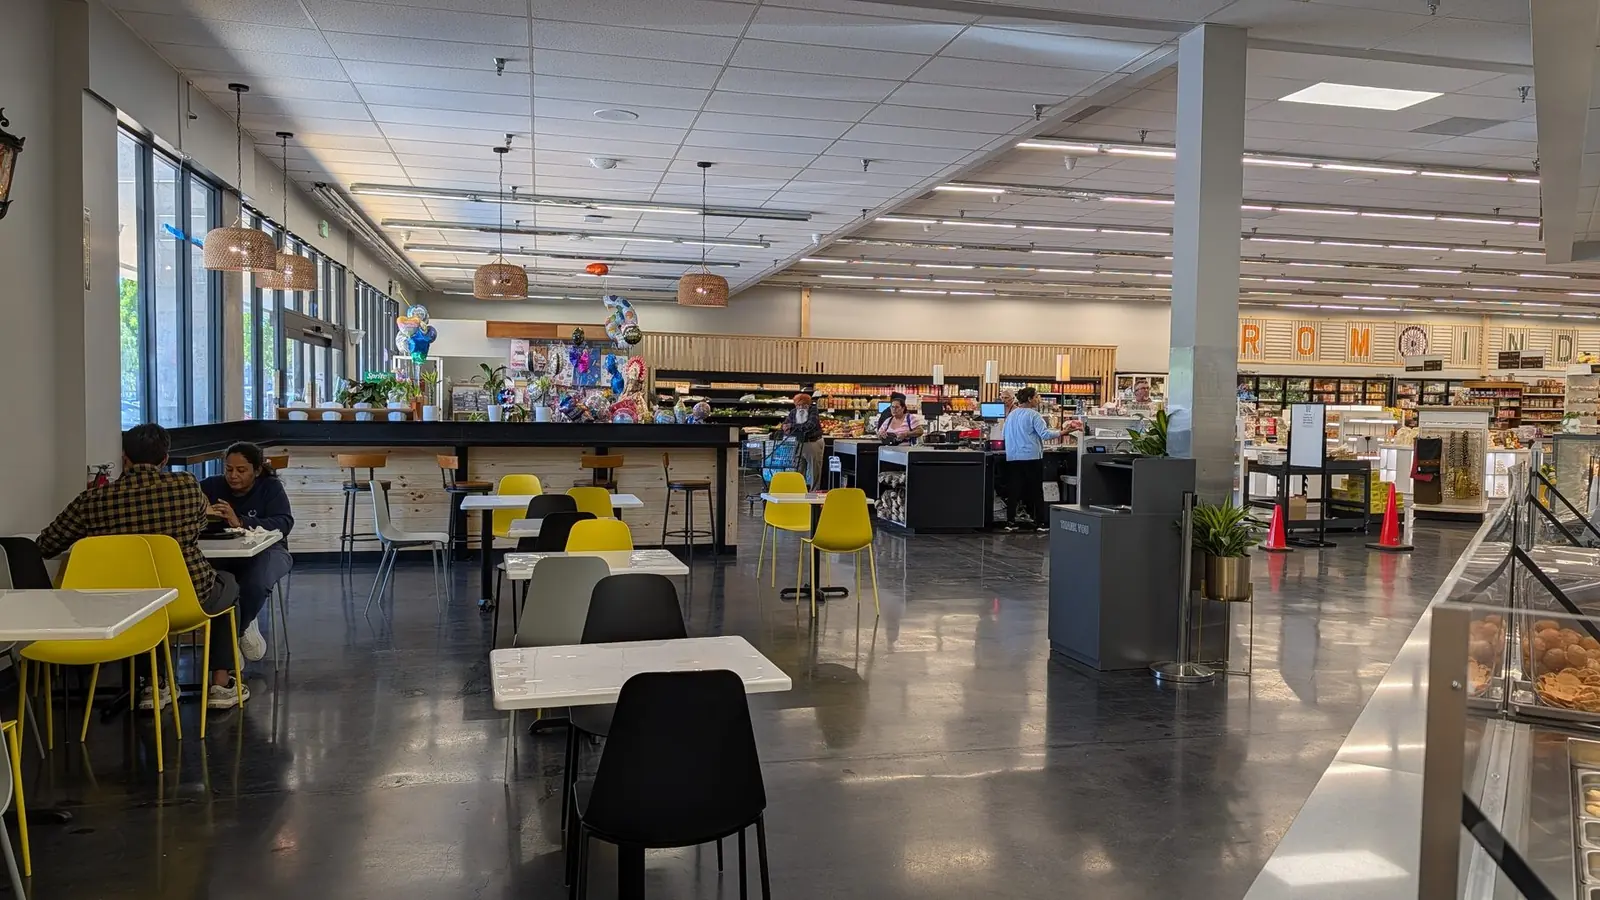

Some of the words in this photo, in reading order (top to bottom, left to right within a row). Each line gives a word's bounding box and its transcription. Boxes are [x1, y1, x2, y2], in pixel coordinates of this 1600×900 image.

[366, 372, 388, 380] Sprite
[1060, 520, 1077, 532] THANK
[1078, 523, 1089, 535] YOU
